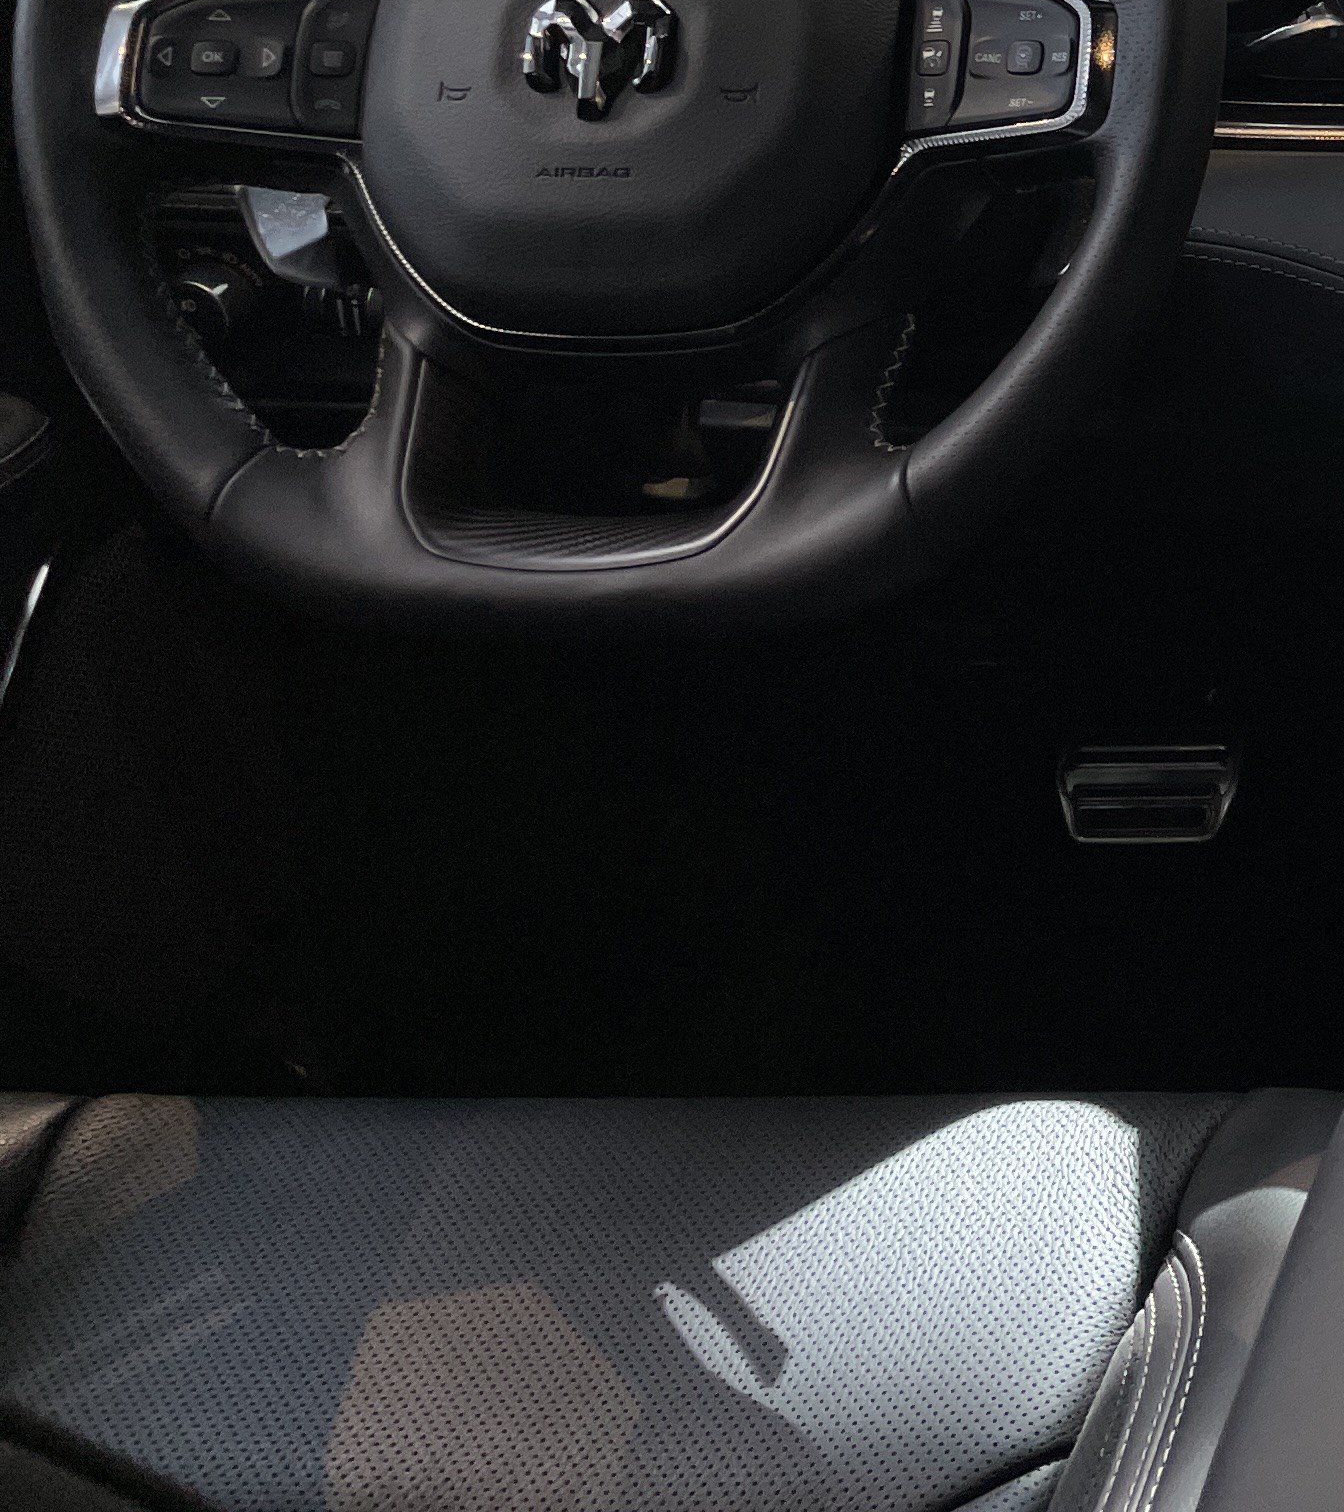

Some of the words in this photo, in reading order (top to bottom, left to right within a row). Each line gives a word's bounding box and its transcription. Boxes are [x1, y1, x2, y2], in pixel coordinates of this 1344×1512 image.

[202, 51, 224, 63] OK
[974, 52, 1002, 64] CANC
[535, 166, 631, 179] AIRBAG
